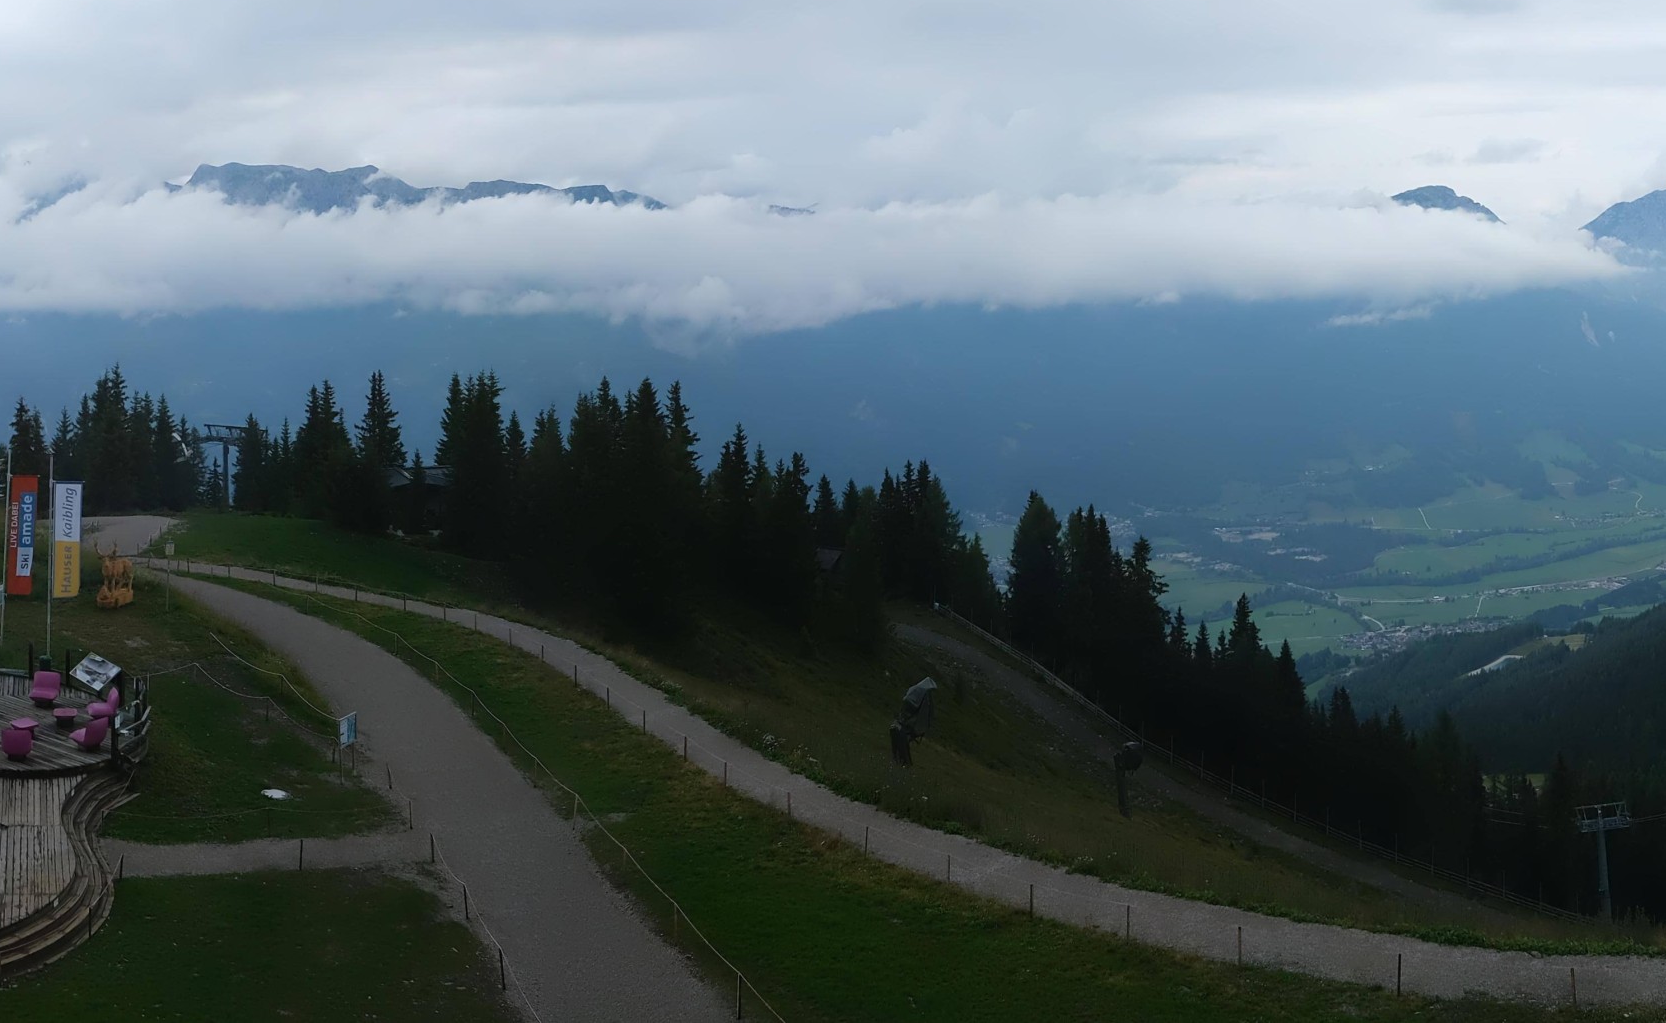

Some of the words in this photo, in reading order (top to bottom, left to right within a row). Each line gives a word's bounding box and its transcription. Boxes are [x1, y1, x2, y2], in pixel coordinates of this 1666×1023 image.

[11, 502, 19, 527] DABEI
[62, 487, 78, 538] Kaibling
[10, 529, 18, 548] LIVE
[20, 554, 30, 570] Ski
[61, 546, 73, 593] HAUSER
